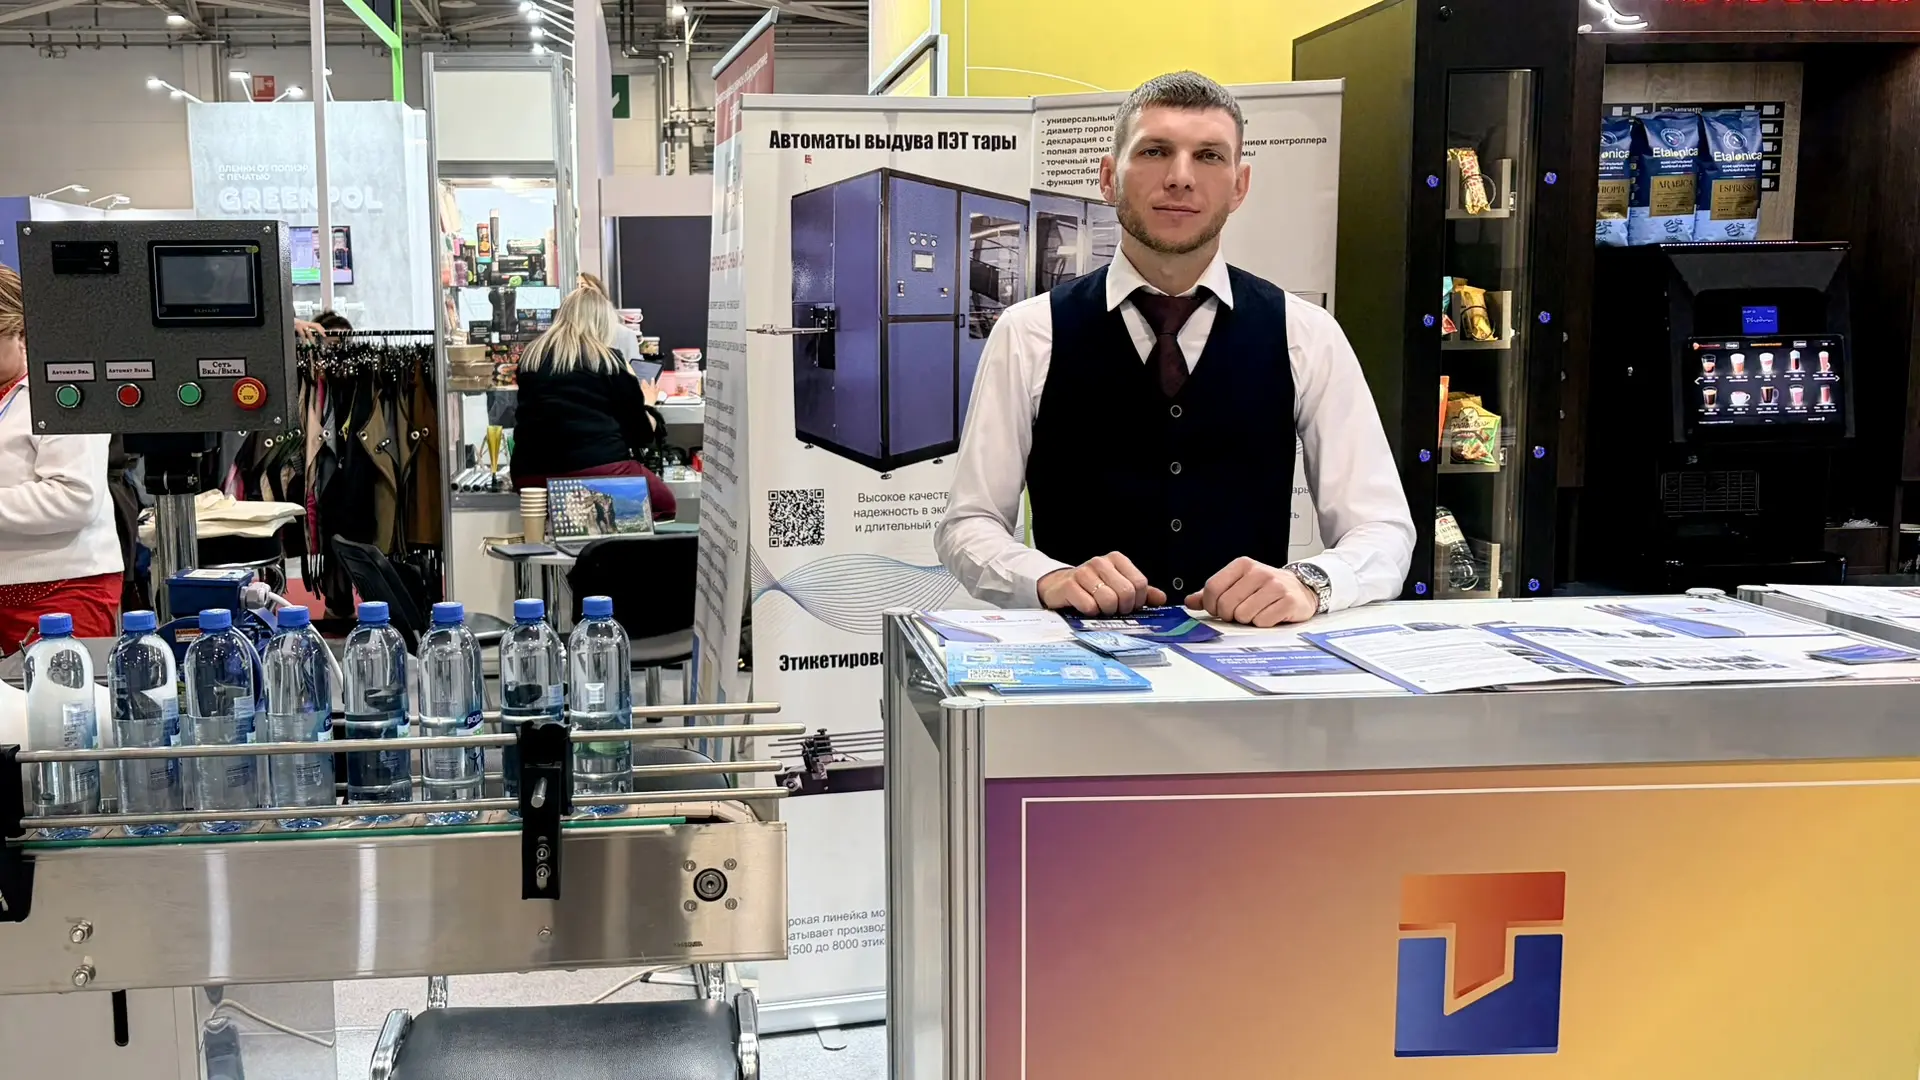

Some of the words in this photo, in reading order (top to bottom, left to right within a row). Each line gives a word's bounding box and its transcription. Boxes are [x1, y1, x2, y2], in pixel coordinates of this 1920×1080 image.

[1047, 114, 1115, 126] универсальный
[1046, 128, 1082, 136] диаметр
[769, 130, 861, 150] Автоматы
[865, 133, 934, 152] выдува
[938, 132, 969, 150] ПЭТ
[972, 133, 1017, 152] тары
[1046, 137, 1097, 146] декларация
[1270, 137, 1327, 146] контроллера
[1653, 146, 1698, 159] Etalonica
[1714, 151, 1762, 162] Etalonica
[1046, 157, 1087, 166] точечный
[218, 164, 256, 173] ПЛЕНКИ
[1046, 179, 1083, 187] функция
[212, 361, 232, 369] Сеть
[202, 367, 244, 376] Вкл./Выкл.
[858, 492, 906, 503] Высокое
[853, 507, 919, 519] надежность
[922, 506, 928, 514] в
[864, 520, 932, 533] длительный
[822, 910, 868, 923] линейка
[871, 909, 886, 918] мо
[788, 927, 834, 941] атывает
[815, 943, 829, 954] до
[832, 938, 859, 950] 8000
